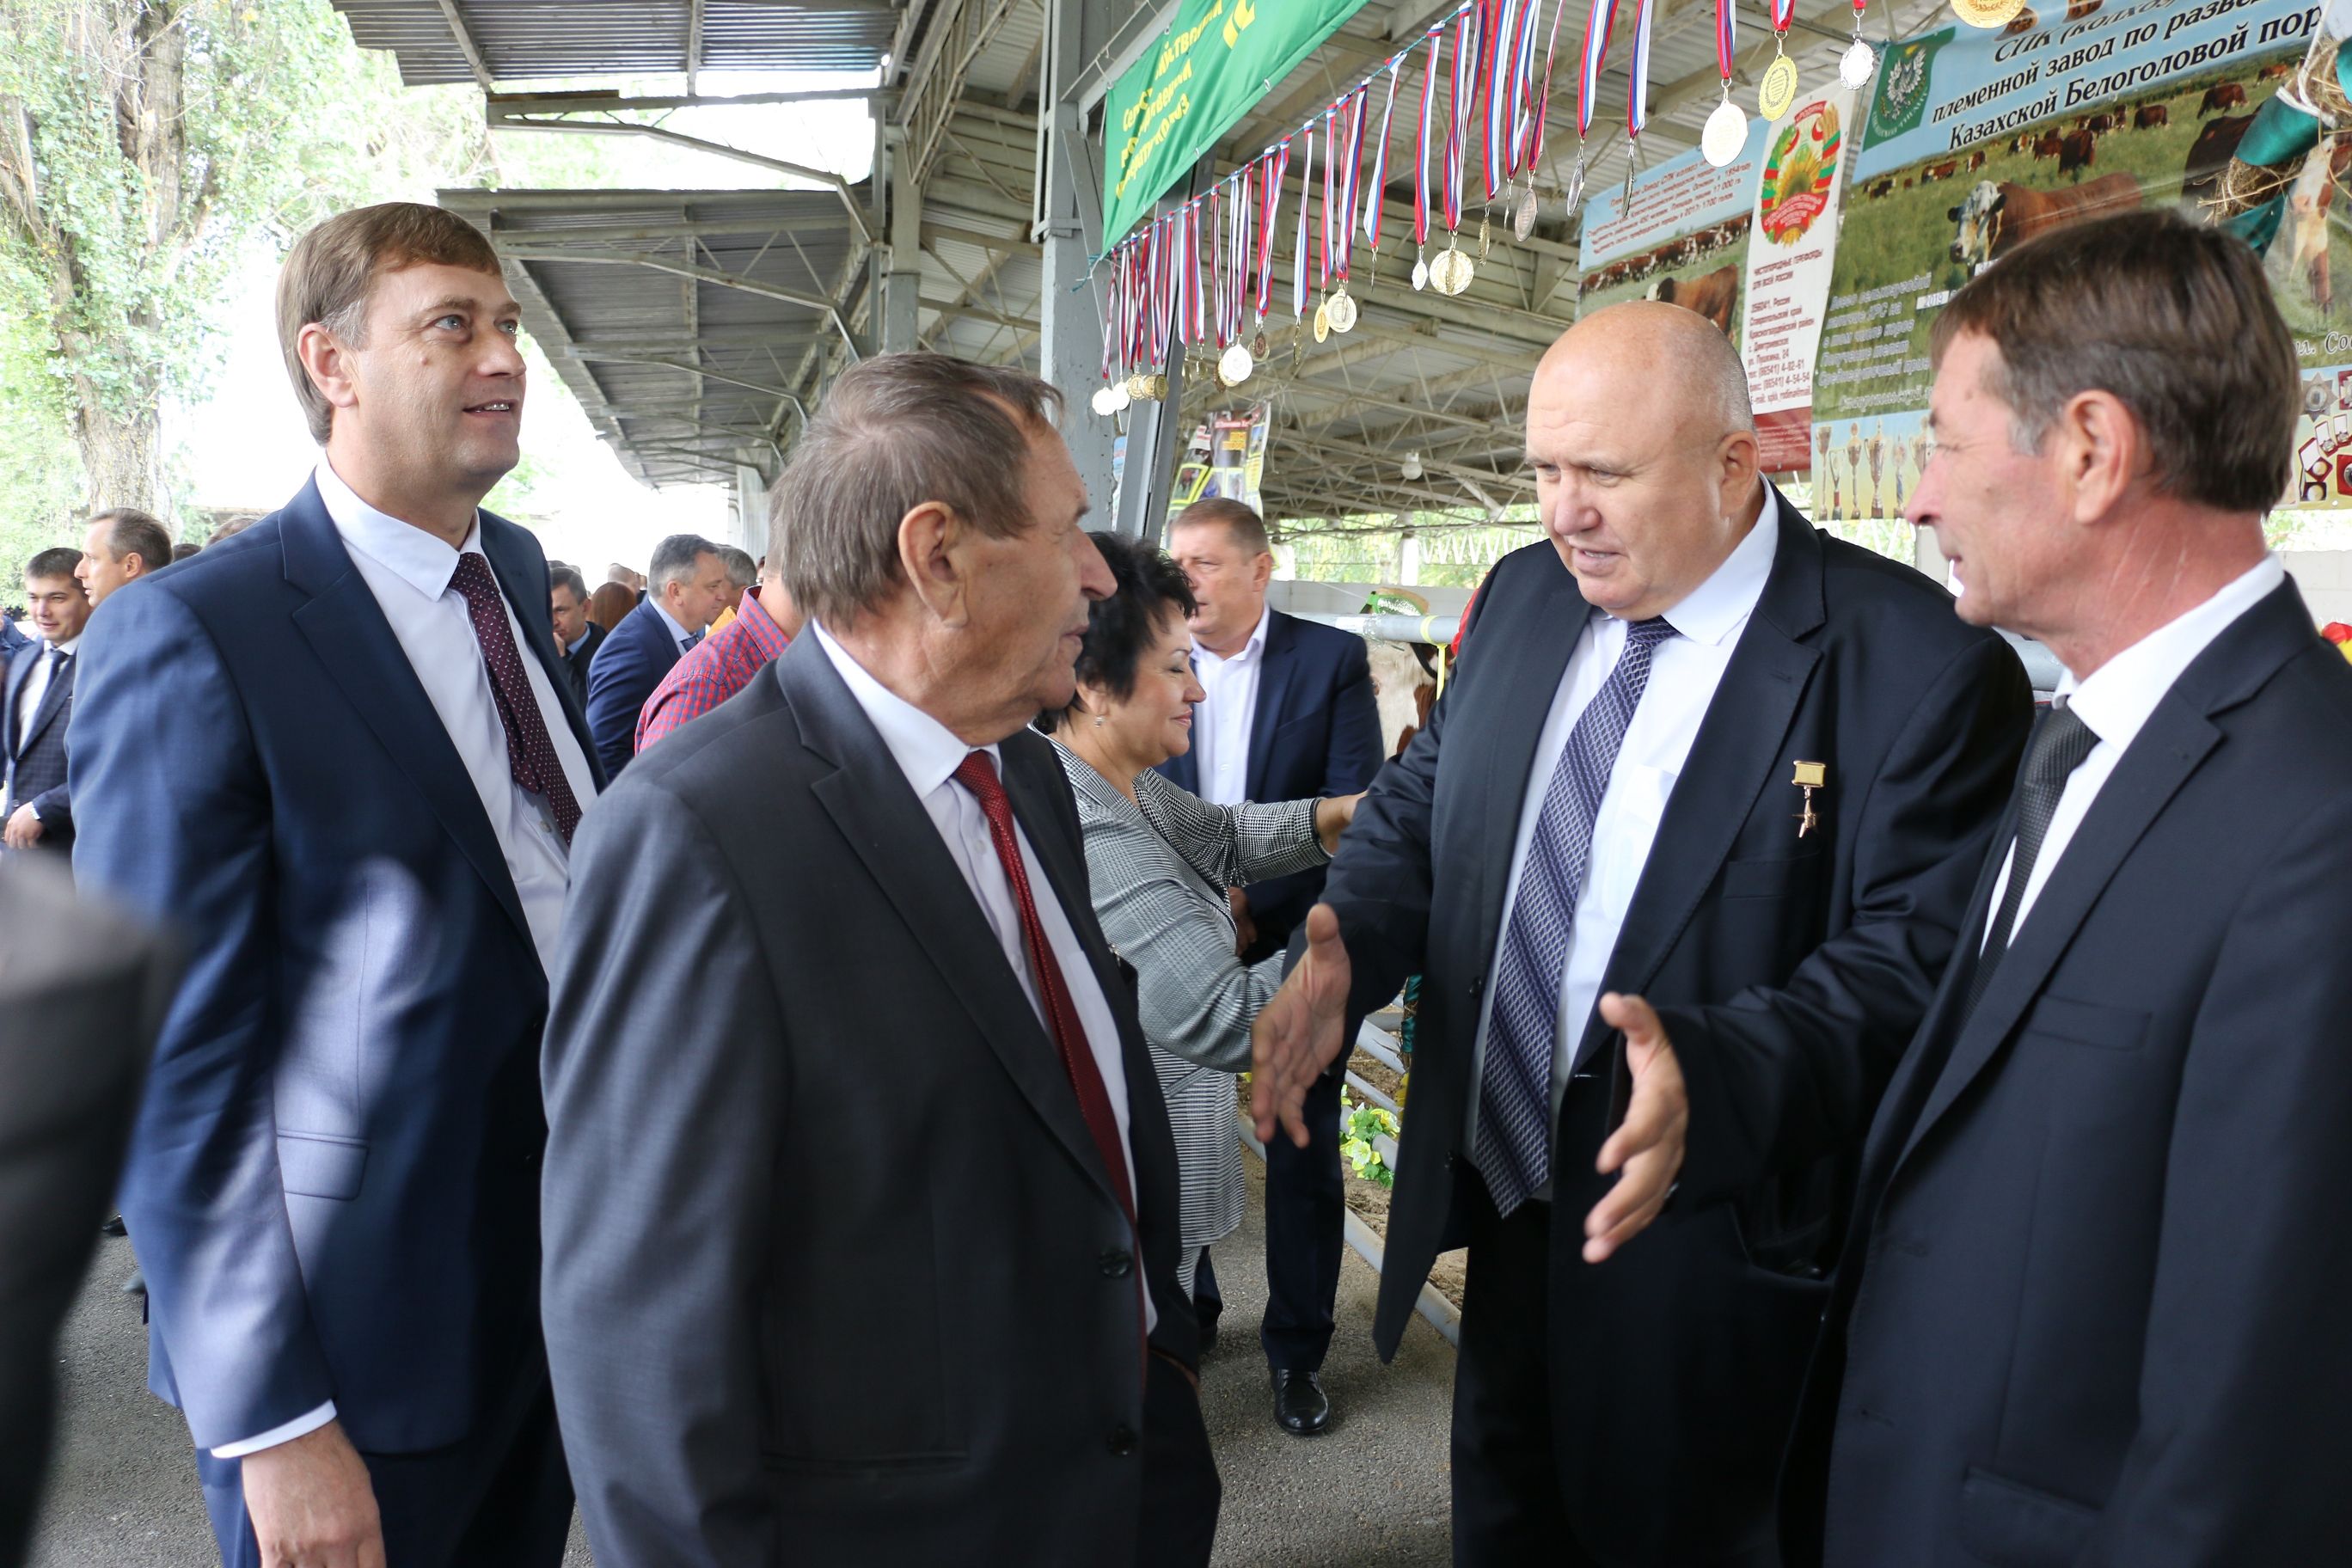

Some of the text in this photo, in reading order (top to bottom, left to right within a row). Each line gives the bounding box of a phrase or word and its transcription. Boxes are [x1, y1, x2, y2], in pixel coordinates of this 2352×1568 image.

[1932, 59, 2039, 124] племенной
[2046, 37, 2116, 77] завод
[2122, 23, 2158, 49] по
[2164, 0, 2258, 40] разв
[1949, 88, 2058, 150] Казахской
[2064, 21, 2249, 107] Белоголовой
[2258, 6, 2323, 44] пор
[1994, 28, 2060, 63] СПК
